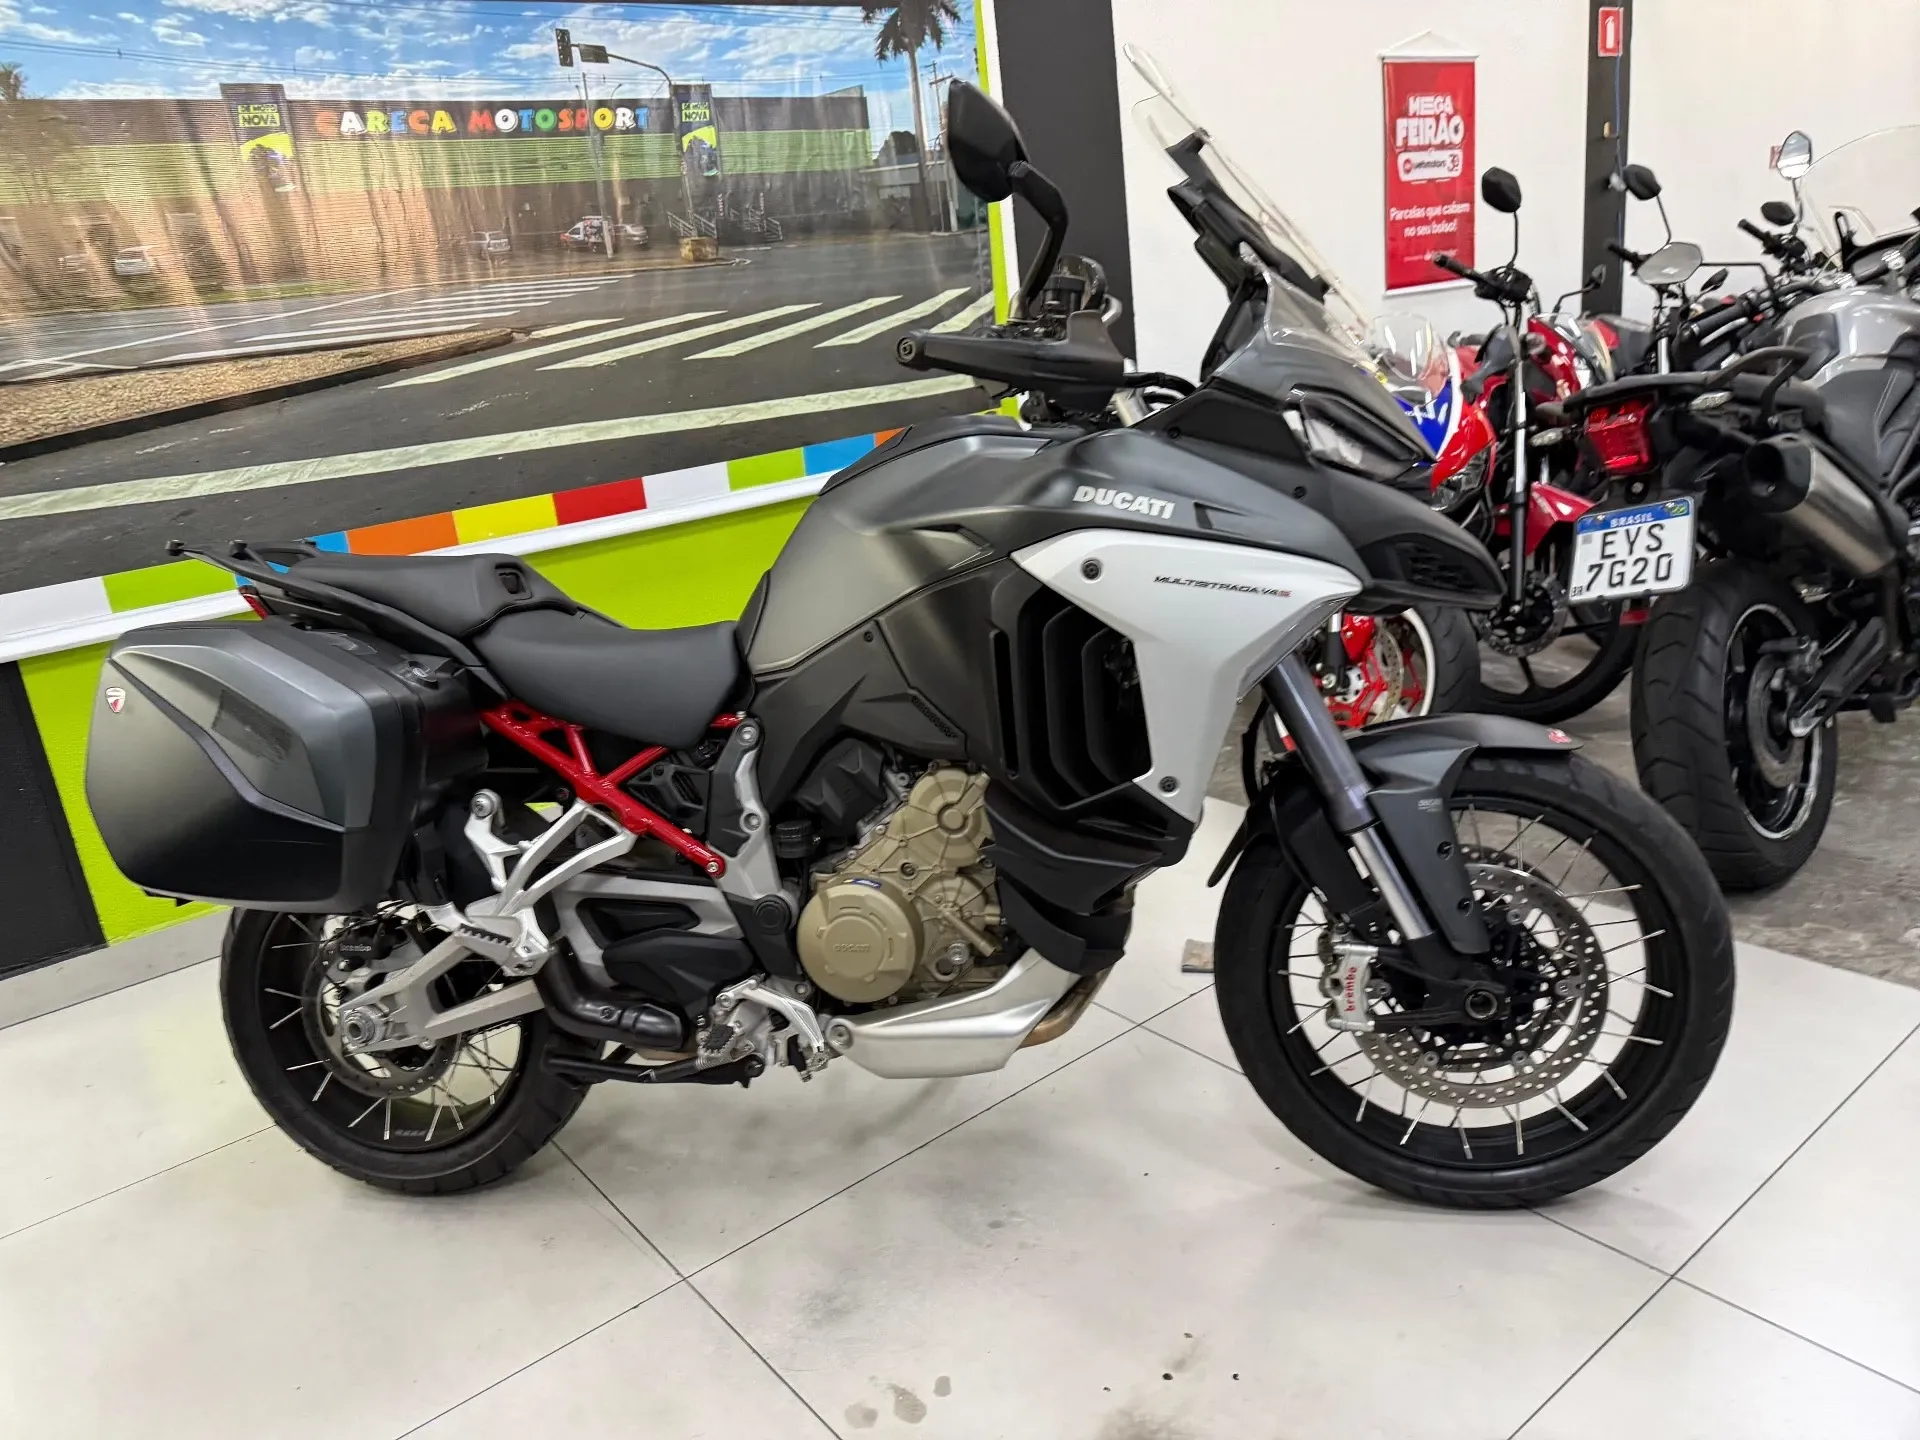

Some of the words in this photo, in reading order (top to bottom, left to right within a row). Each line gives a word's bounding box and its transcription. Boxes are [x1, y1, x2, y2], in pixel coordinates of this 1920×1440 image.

[684, 111, 708, 121] NOVA
[1408, 95, 1453, 116] MEGA
[242, 115, 277, 125] NOVA
[315, 109, 457, 135] CARECA
[467, 107, 649, 133] MOTOSPORT
[1396, 113, 1464, 147] FEIRÃO
[1390, 205, 1426, 220] Parcelas
[1426, 205, 1442, 219] que
[1442, 201, 1470, 215] cabem
[1404, 226, 1416, 237] no
[1417, 224, 1432, 236] seu
[1073, 486, 1176, 519] DUCATI
[1610, 513, 1654, 528] BRASIL
[1601, 523, 1665, 559] EYS
[1586, 553, 1673, 592] 7G20
[1345, 966, 1357, 1012] brembo
